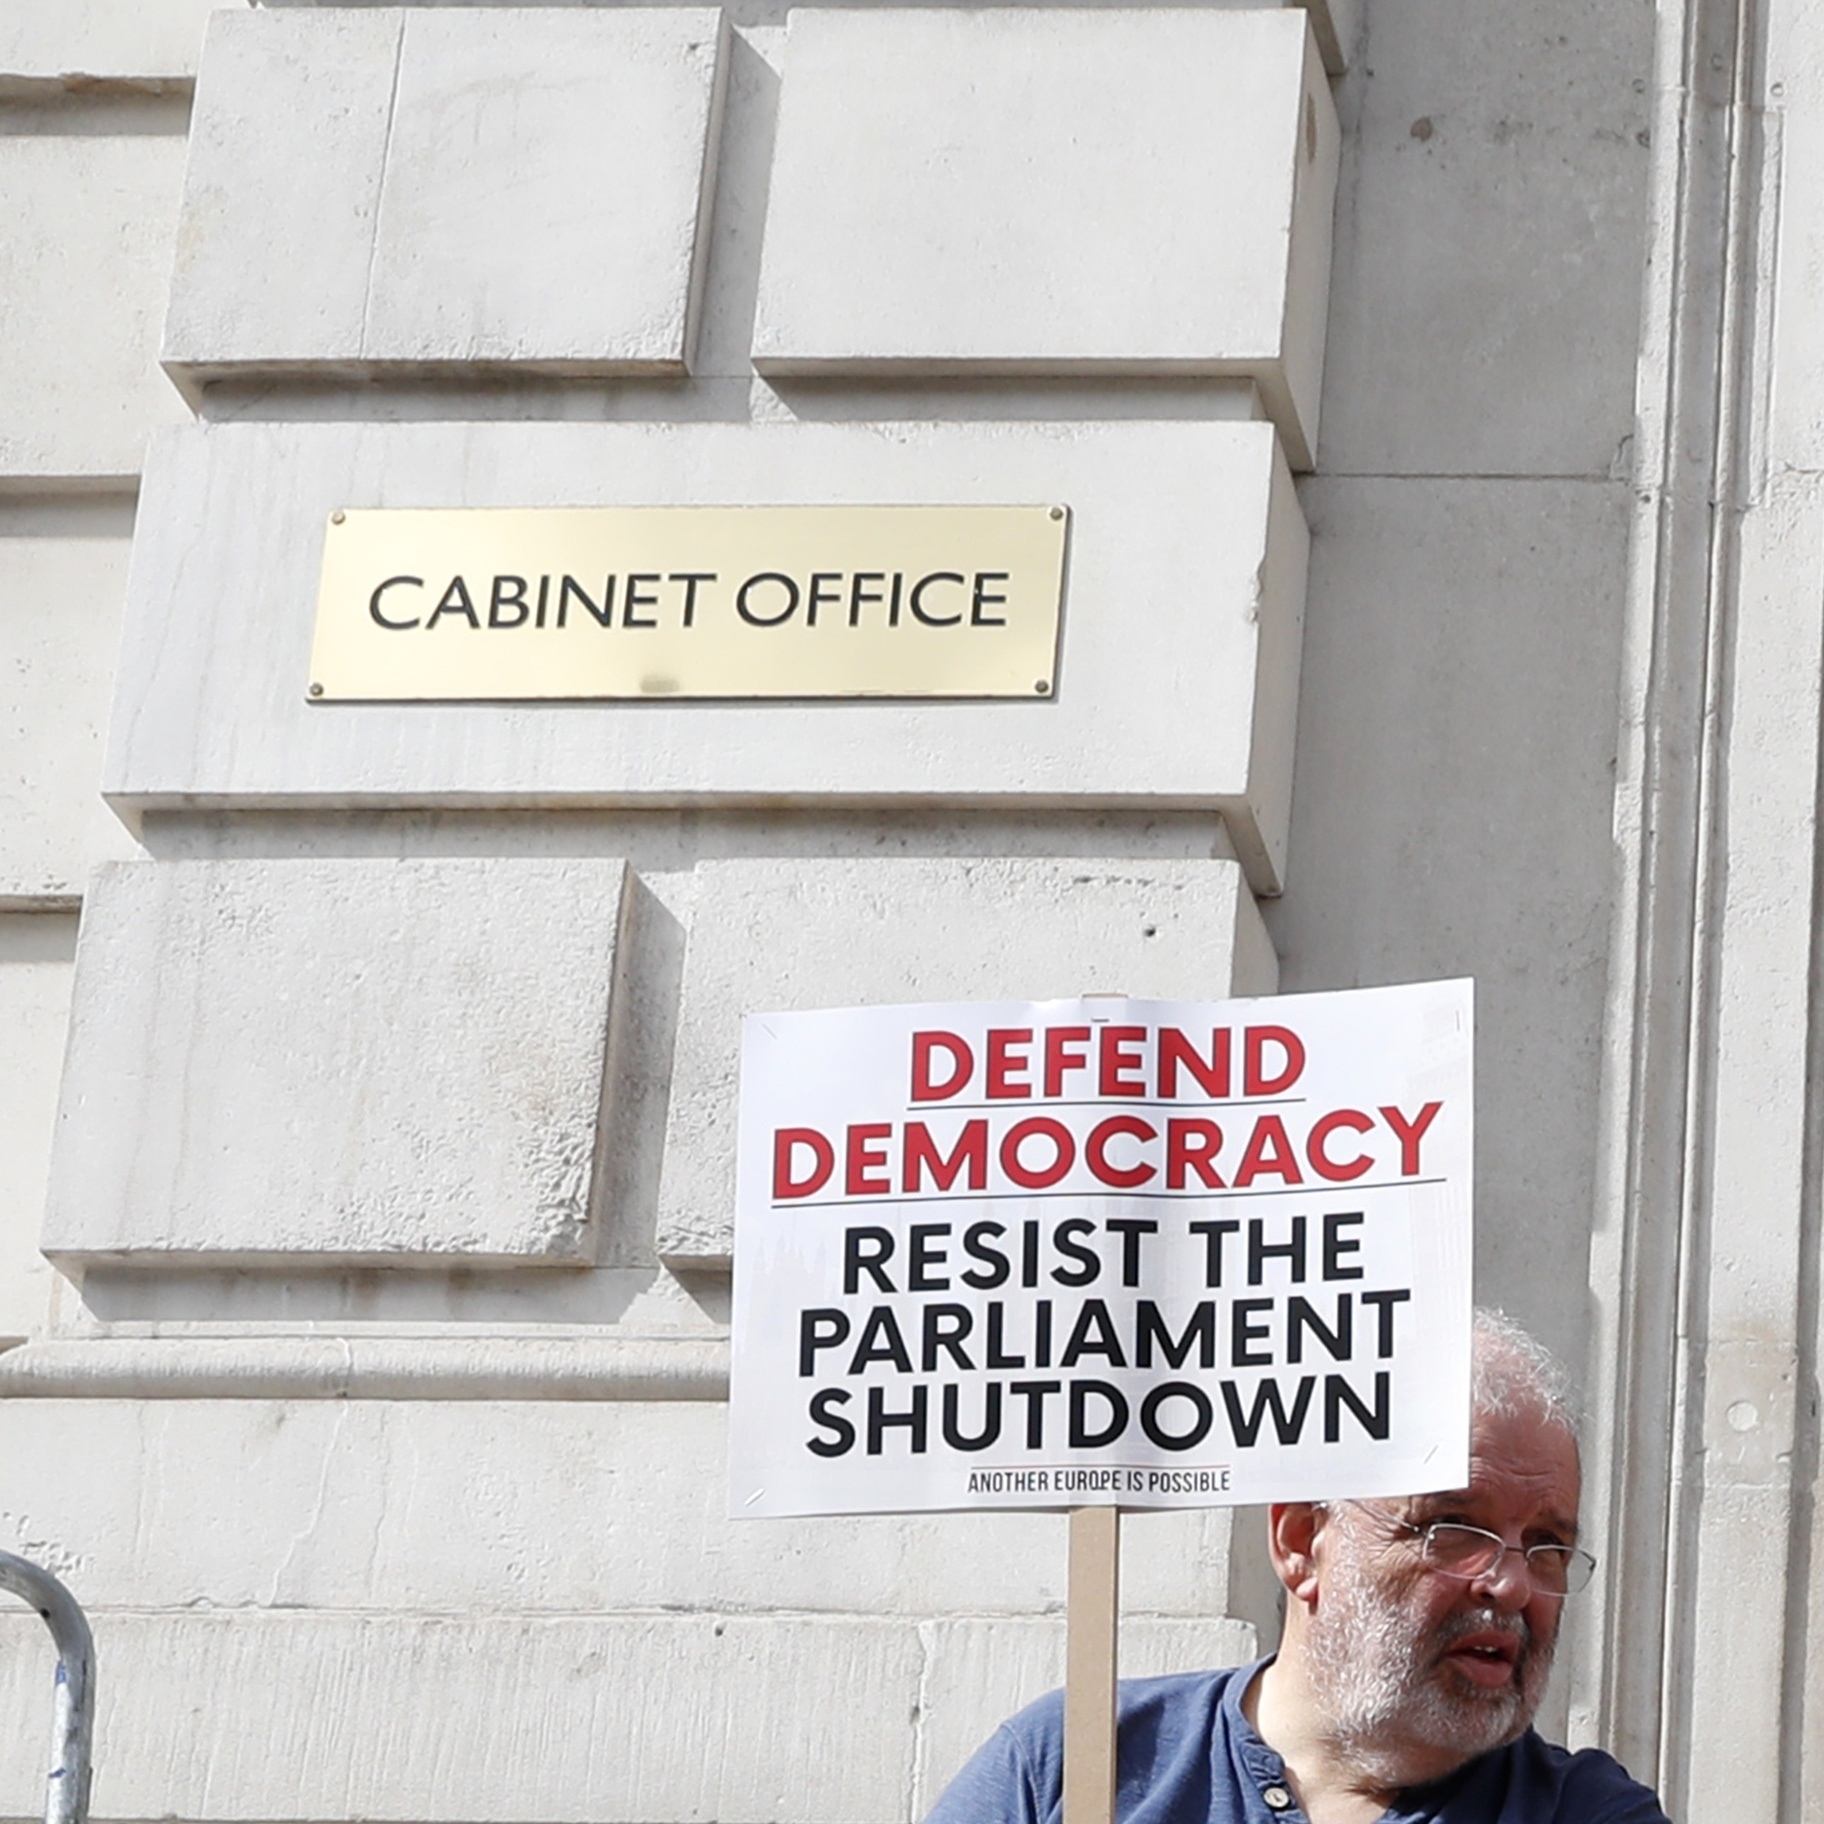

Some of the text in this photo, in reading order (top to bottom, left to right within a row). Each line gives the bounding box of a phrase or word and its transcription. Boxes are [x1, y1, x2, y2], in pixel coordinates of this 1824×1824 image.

[367, 571, 1009, 631] CABINET OFFICE
[910, 1025, 1306, 1101] DEFEND
[772, 1101, 1444, 1199] DEMOCRACY
[843, 1211, 1364, 1295] RESIST THE
[799, 1288, 1411, 1378] PARLIAMENT
[806, 1371, 1391, 1458] SHUTDOWN
[968, 1469, 1231, 1492] ANOTHER EUROPE IS POSSIBLE
